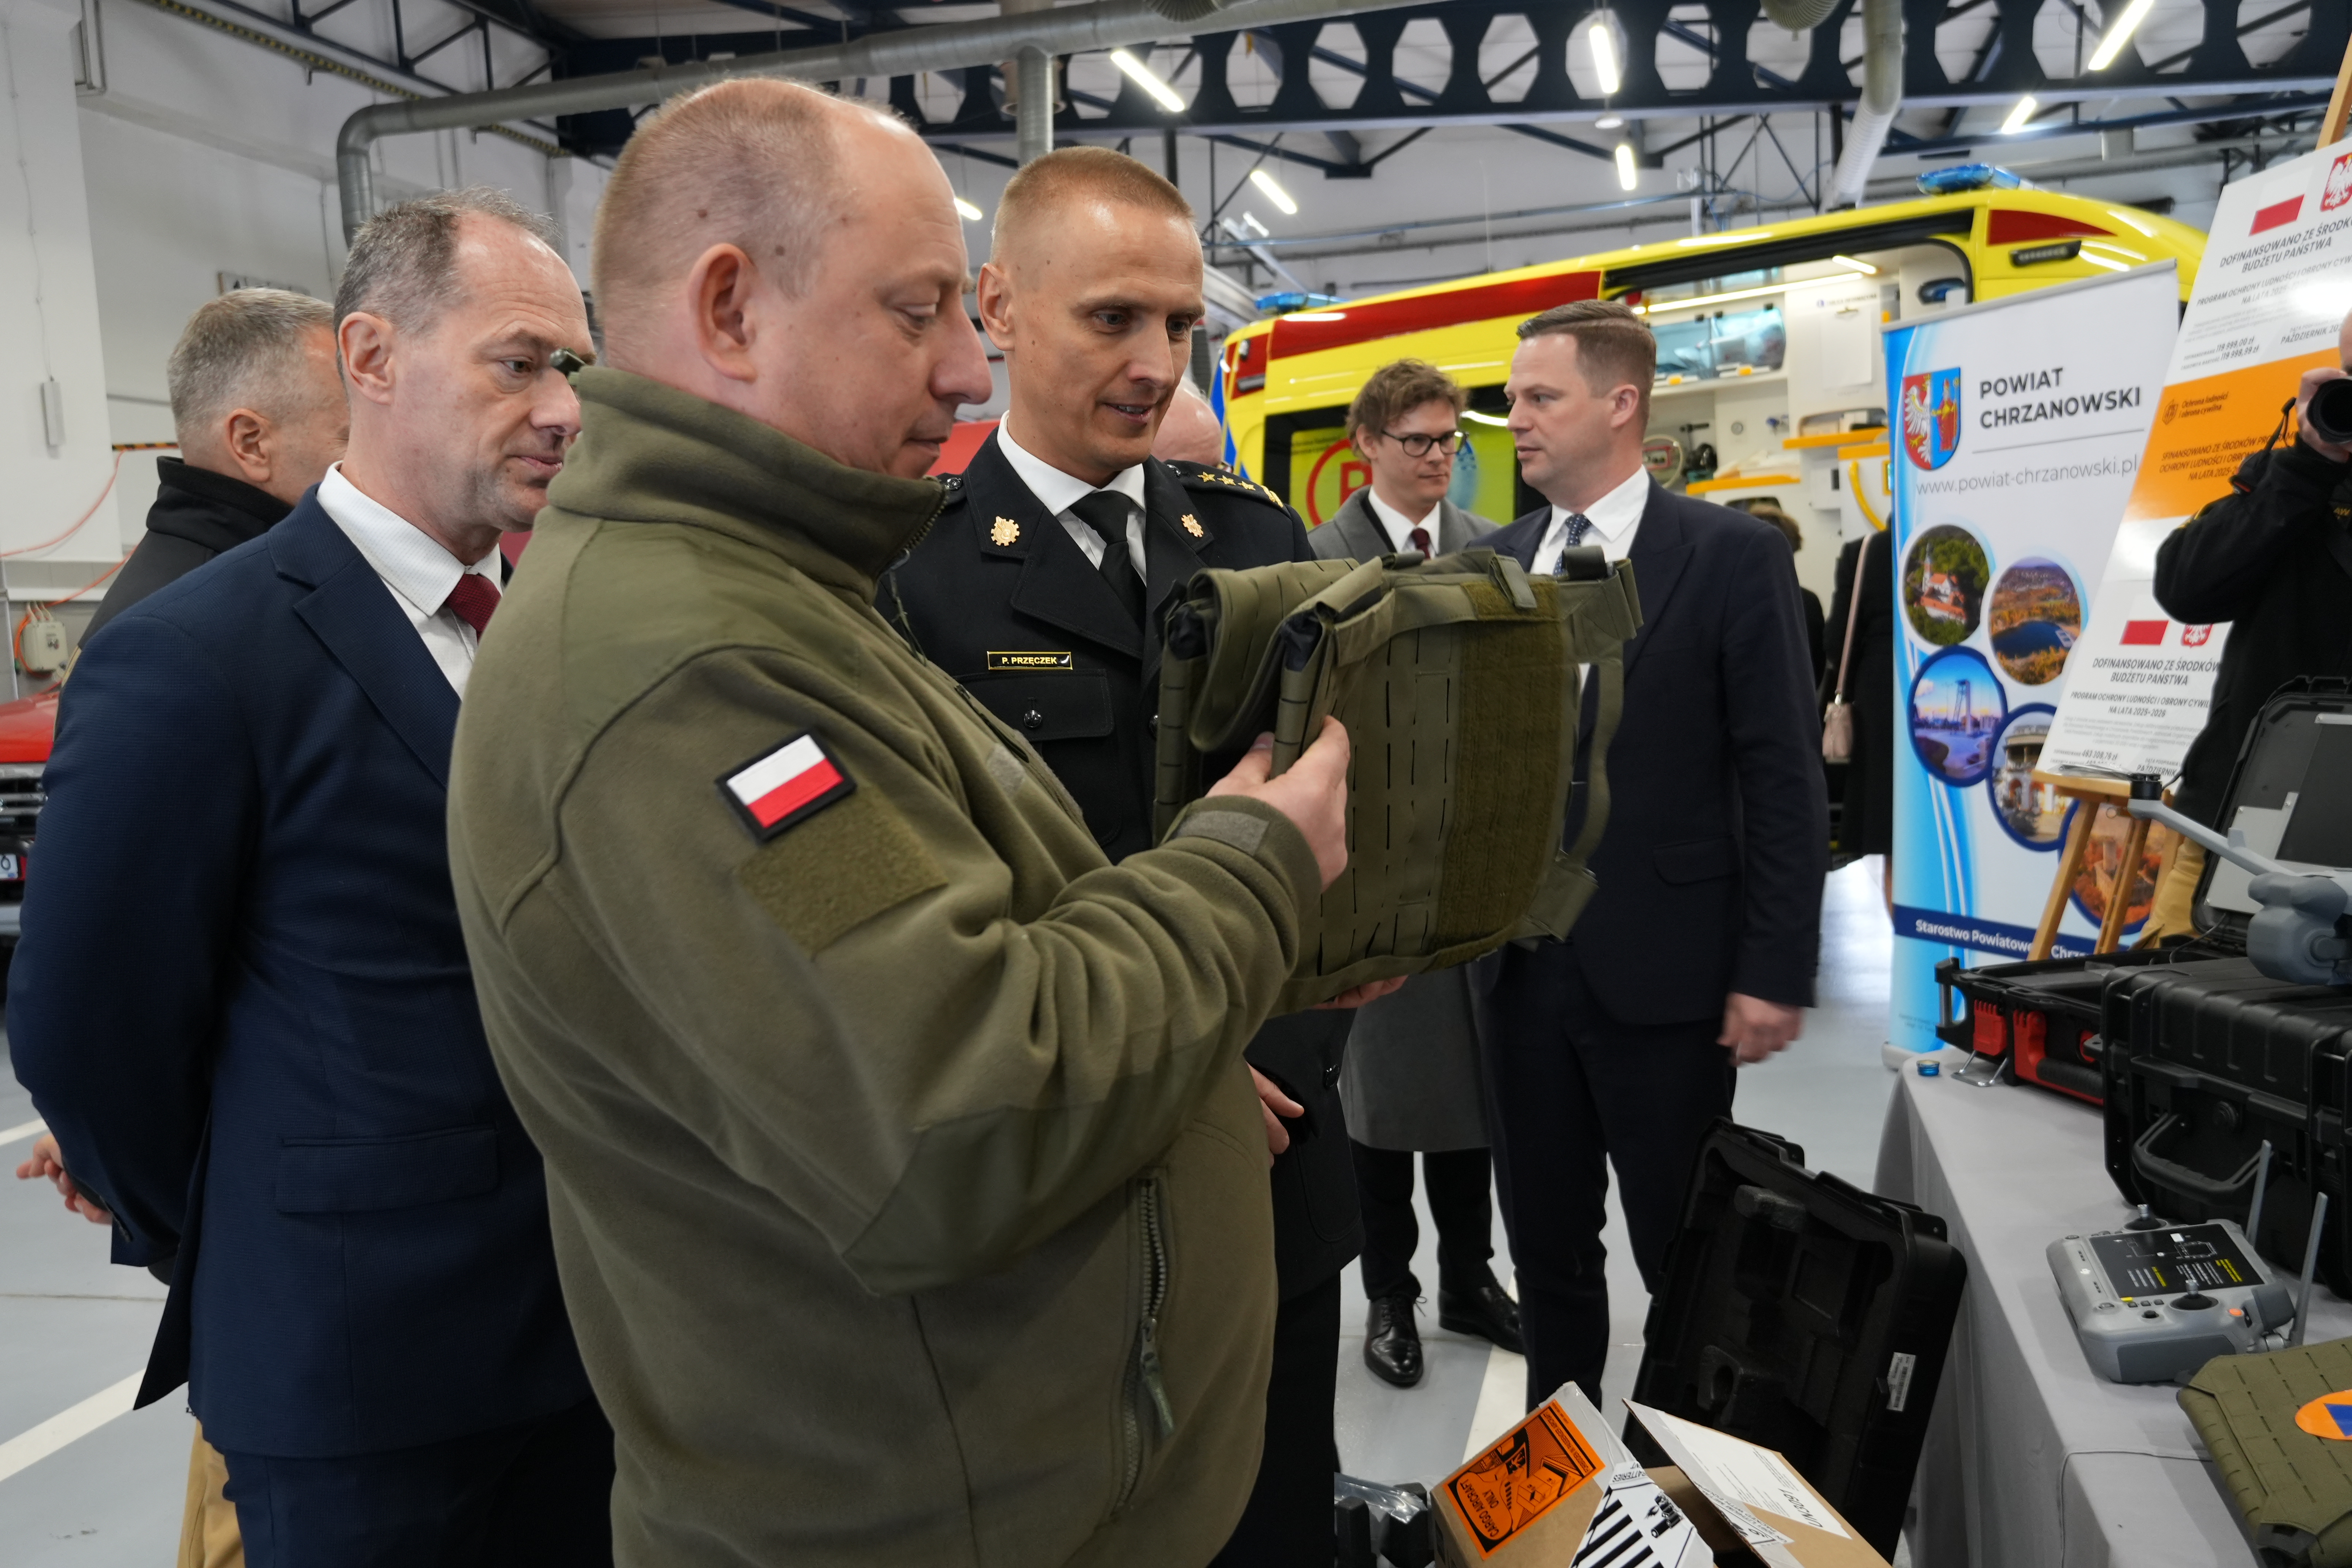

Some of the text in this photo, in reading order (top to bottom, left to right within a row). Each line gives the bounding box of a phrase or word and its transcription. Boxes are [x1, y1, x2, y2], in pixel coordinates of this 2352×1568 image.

[2220, 216, 2352, 267] DOFINANSOWANO ZE ŚRODK
[2241, 236, 2332, 273] BUDŻETU PAŃSTWA
[2196, 291, 2227, 307] PROGRAM
[2228, 280, 2260, 297] OCHRONY
[2261, 270, 2295, 287] LUDNOŚCI
[2301, 260, 2331, 276] OBRONY
[2333, 254, 2352, 267] CYW
[2241, 296, 2251, 305] NA
[2252, 291, 2269, 302] LATA
[2248, 336, 2255, 345] zł
[2281, 326, 2327, 344] PAŹDZIERNIK
[2253, 344, 2260, 353] zł
[1979, 367, 2063, 400] POWIAT
[1979, 387, 2140, 430] CHRZANOWSKI
[2161, 444, 2212, 461] SFINANSOWANO
[2212, 443, 2221, 453] ZE
[2221, 436, 2257, 452] ŚRODKÓW
[2159, 460, 2191, 473] OCHRONY
[2190, 455, 2222, 468] LUDNOŚCI
[2188, 466, 2237, 481] NA LATA 2025-2
[1916, 454, 2137, 495] www.powiat-chrzanowski.pl
[1011, 656, 1057, 665] PRZĘCZEK
[2092, 658, 2163, 670] DOFINANSOWANO
[2164, 660, 2174, 671] ZE
[2110, 670, 2188, 685] BUDŻETU PAŃSTWA
[2070, 691, 2097, 700] PROGRAM
[2098, 693, 2126, 702] OCHRONY
[2127, 694, 2156, 705] LUDNOŚCI
[2161, 697, 2188, 707] OBRONY
[2188, 699, 2209, 708] CYWIL
[2117, 707, 2132, 715] LATA
[2132, 707, 2166, 718] 2025-2026
[1915, 919, 1969, 941] Starostwo
[1460, 1479, 1499, 1537] CARGO AIRCRAFT
[1482, 1489, 1499, 1509] ONLY
[1778, 1487, 1823, 1528] UN3091
